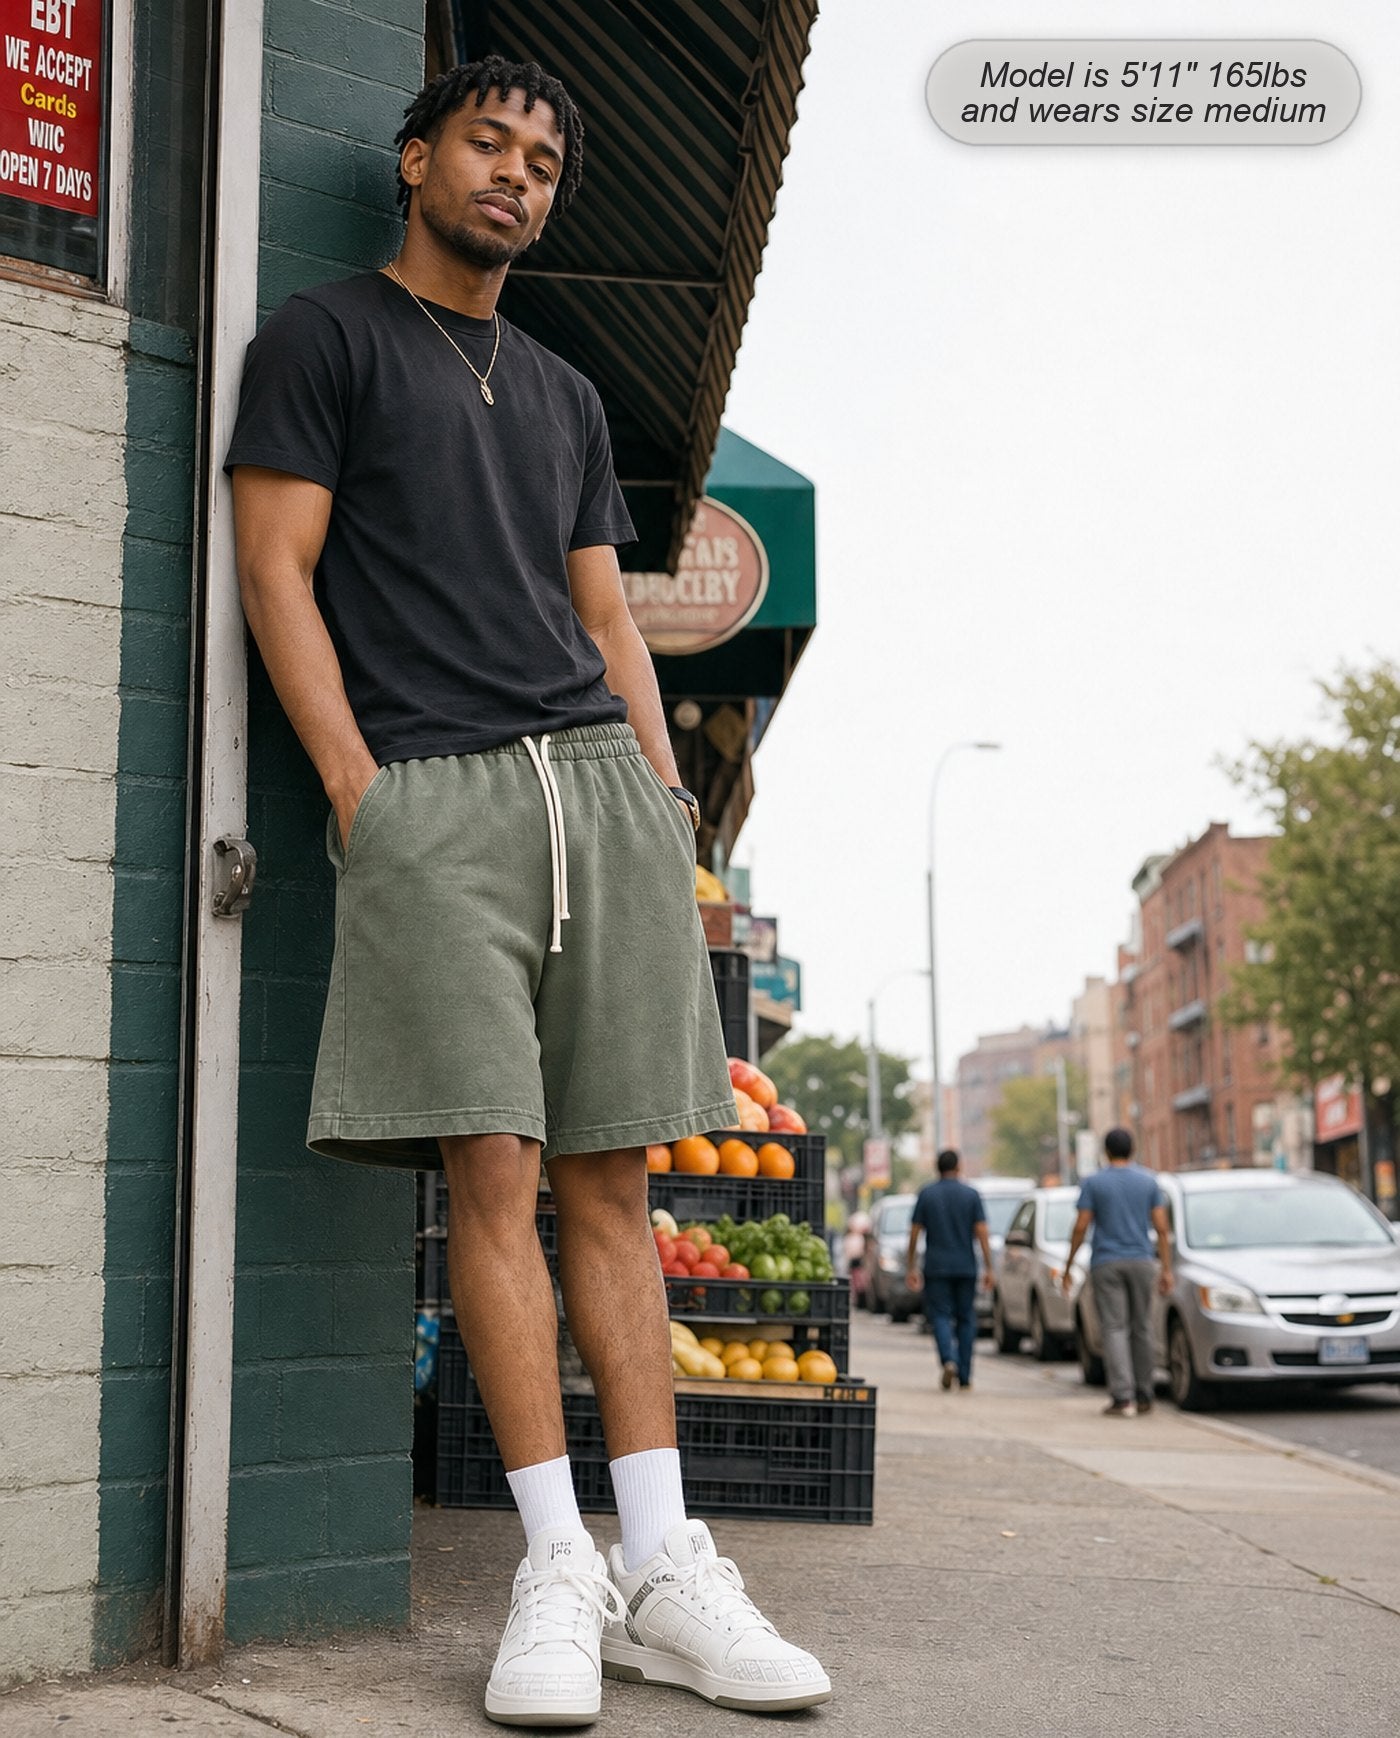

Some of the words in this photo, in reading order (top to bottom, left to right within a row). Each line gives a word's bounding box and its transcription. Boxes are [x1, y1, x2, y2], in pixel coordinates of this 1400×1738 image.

[31, 0, 76, 39] EBT
[5, 35, 30, 73] WE
[35, 45, 92, 91] ACCEPT
[20, 82, 77, 119] Cards
[0, 149, 39, 188] OPEN
[43, 160, 52, 191] 7
[56, 163, 92, 202] DAYS
